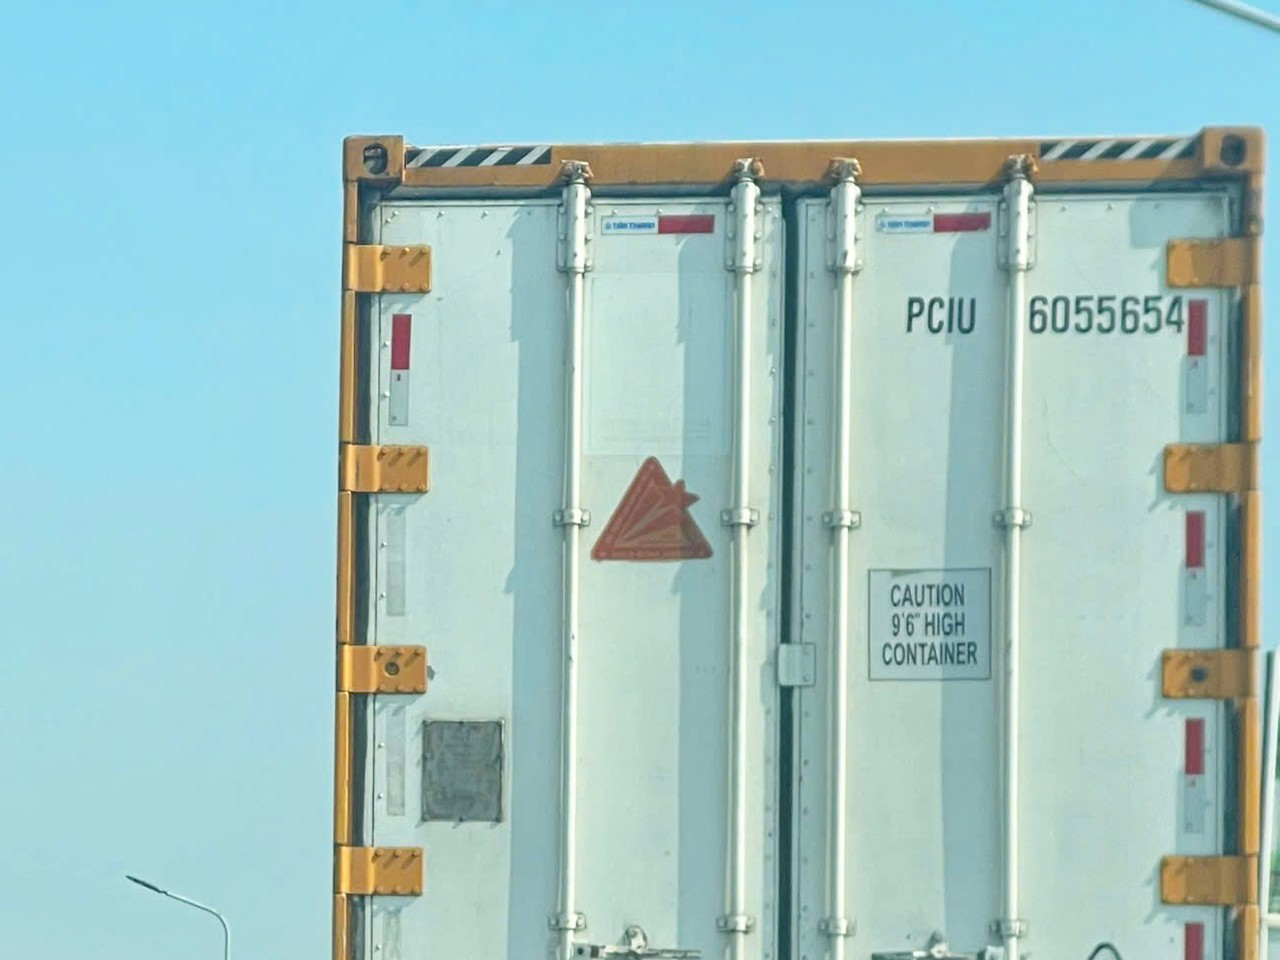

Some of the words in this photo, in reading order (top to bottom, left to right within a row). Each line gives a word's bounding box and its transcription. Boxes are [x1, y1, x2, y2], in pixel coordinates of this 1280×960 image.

[906, 296, 976, 334] PCIU
[1028, 295, 1186, 334] 6055654
[890, 583, 965, 607] CAUTION
[924, 612, 965, 636] HIGH
[882, 642, 978, 666] CONTAINER
